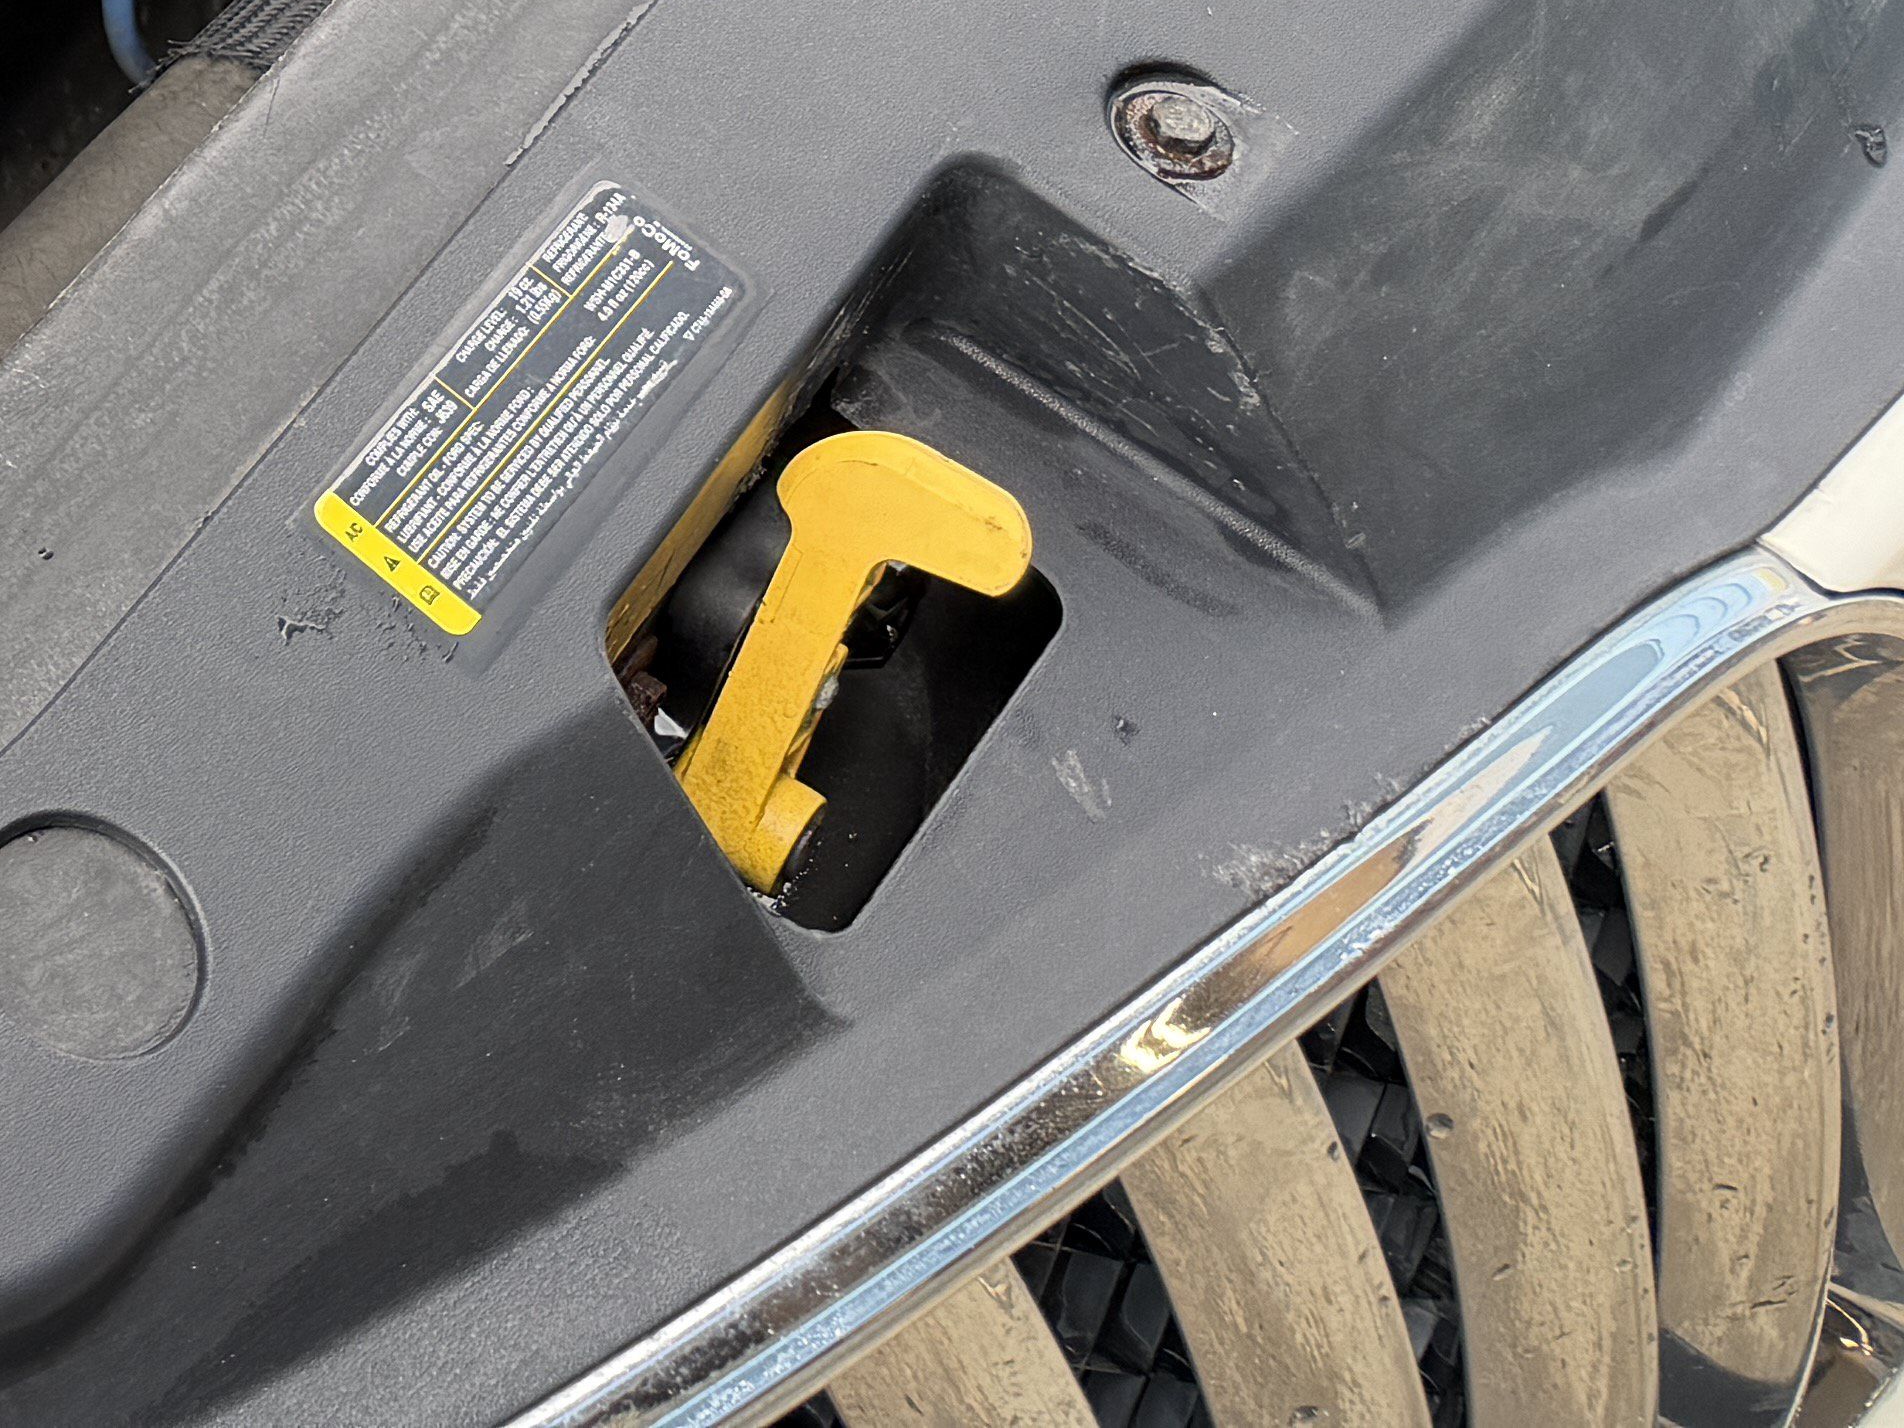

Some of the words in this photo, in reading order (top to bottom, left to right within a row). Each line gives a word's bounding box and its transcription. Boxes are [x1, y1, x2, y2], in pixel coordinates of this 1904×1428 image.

[593, 188, 627, 226] R-134A
[629, 212, 701, 273] FoMoCo
[420, 388, 445, 414] SAE
[455, 499, 487, 535] SYSTEM
[480, 489, 496, 505] TO
[528, 433, 544, 449] BY
[454, 545, 470, 561] EN
